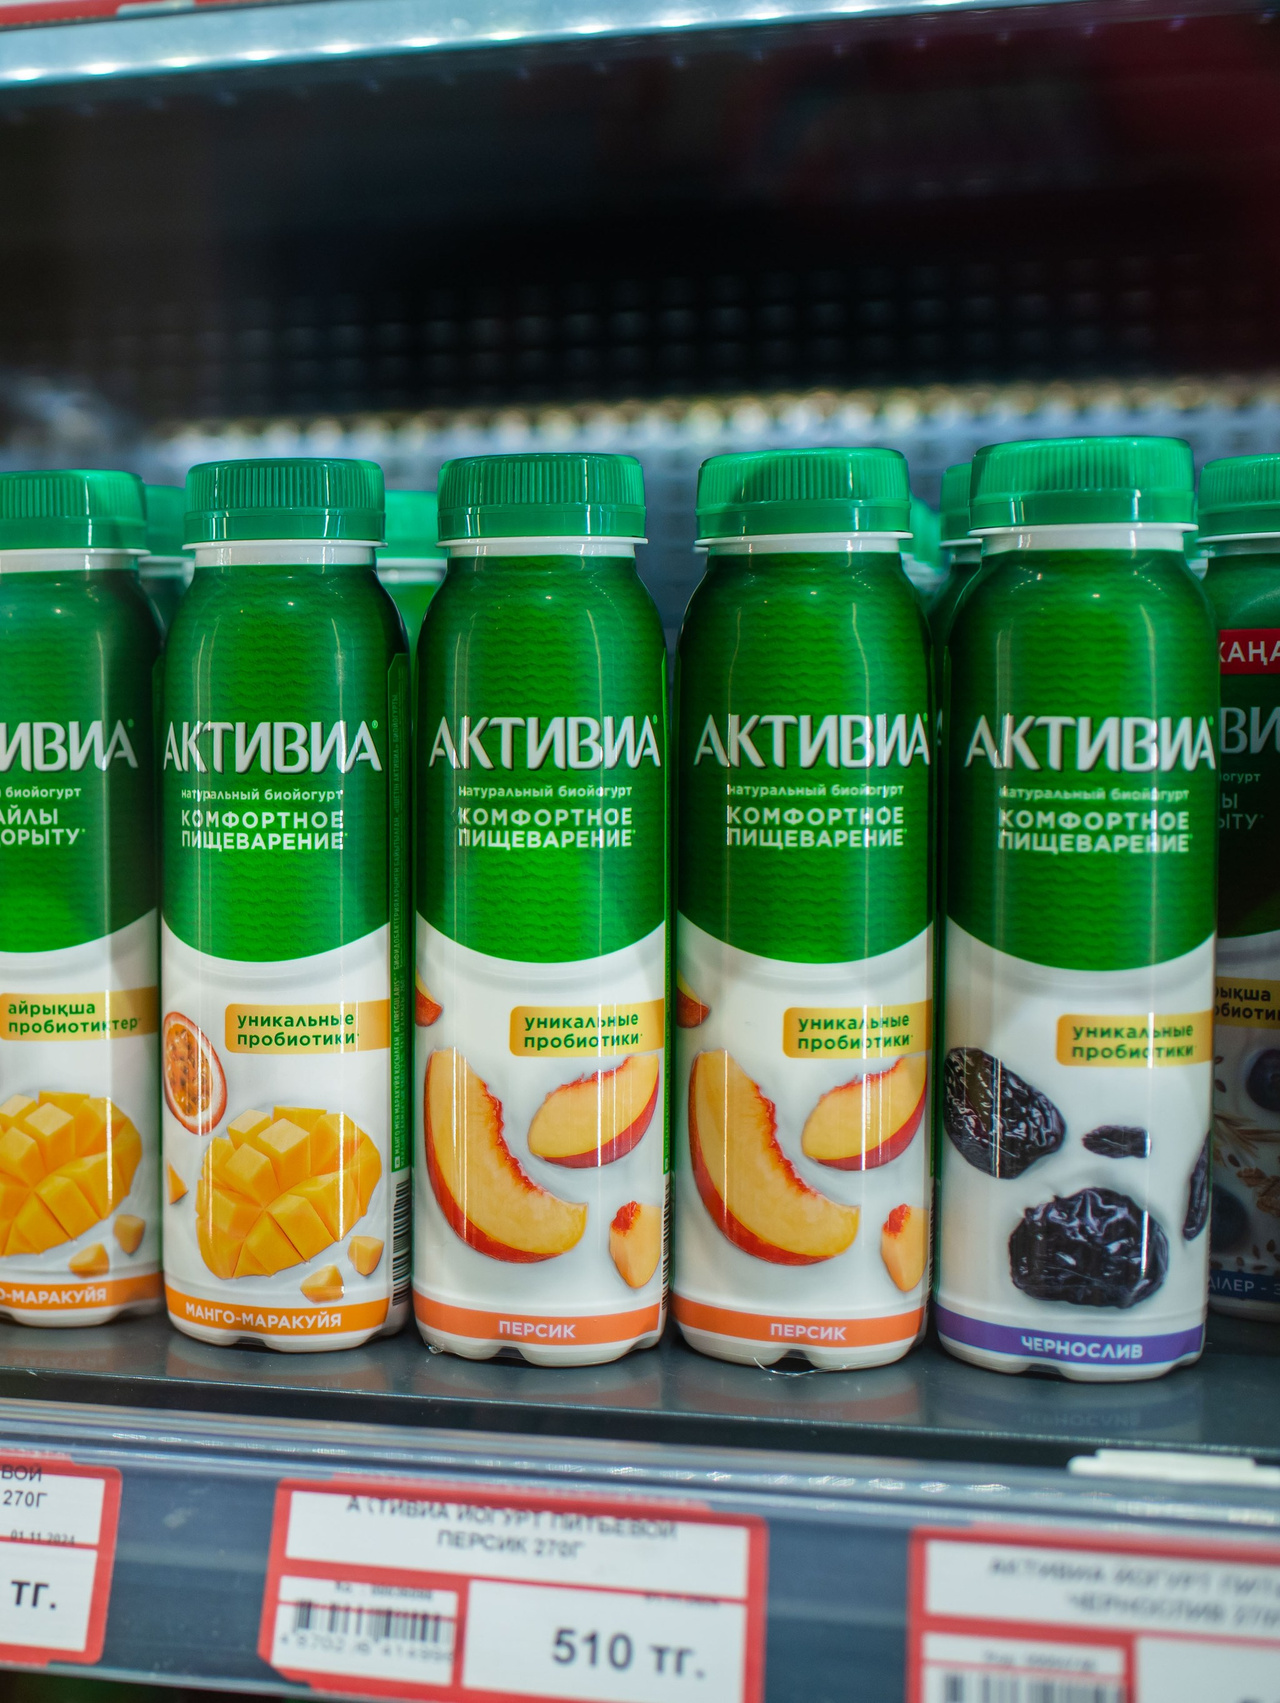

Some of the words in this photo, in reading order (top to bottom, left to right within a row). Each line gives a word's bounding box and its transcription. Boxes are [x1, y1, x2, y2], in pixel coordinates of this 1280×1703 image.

[163, 719, 382, 773] АКТИВИА
[429, 715, 661, 770] АКТИВИА
[693, 713, 930, 768] АКТИВИА
[964, 713, 1216, 772] АКТИВИА
[5, 786, 82, 799] биойогурт
[181, 788, 260, 801] натуральный
[264, 788, 343, 801] биойогурт
[558, 785, 632, 798] биойогурт
[831, 784, 904, 797] биойогурт
[181, 809, 343, 829] КОМФОРТНОЕ
[458, 806, 632, 826] КОМФОРТНОЕ
[727, 805, 904, 825] КОМФОРТНОЕ
[998, 808, 1189, 830] КОМФОРТНОЕ
[181, 830, 344, 851] ПИЩЕВАРЕНИЕ
[458, 828, 632, 850] ПИЩЕВАРЕНИЕ
[727, 827, 904, 849] ПИЩЕВАРЕНИЕ
[998, 830, 1189, 854] ПИЩЕВАРЕНИЕ
[8, 1001, 96, 1017] айрықша
[8, 1017, 138, 1035] пробиотиктер
[237, 1014, 354, 1029] уникальные
[525, 1014, 639, 1031] уникальные
[798, 1015, 910, 1032] уникальные
[237, 1032, 355, 1048] пробиотики
[524, 1033, 639, 1051] пробиотики
[1073, 1024, 1193, 1041] уникальные
[798, 1034, 910, 1052] пробиотики
[185, 1302, 341, 1329] МАНГО-МАРАКУЙЯ
[499, 1320, 576, 1339] ПЕРСИК
[770, 1323, 846, 1340] ПЕРСИК
[1021, 1335, 1143, 1359] ЧЕРНОСЛИВ
[3, 1489, 48, 1508] 270Г
[437, 1529, 526, 1553] ПЕРСИК
[11, 1579, 56, 1609] тг.
[552, 1627, 633, 1671] 510
[649, 1643, 705, 1680] тг.
